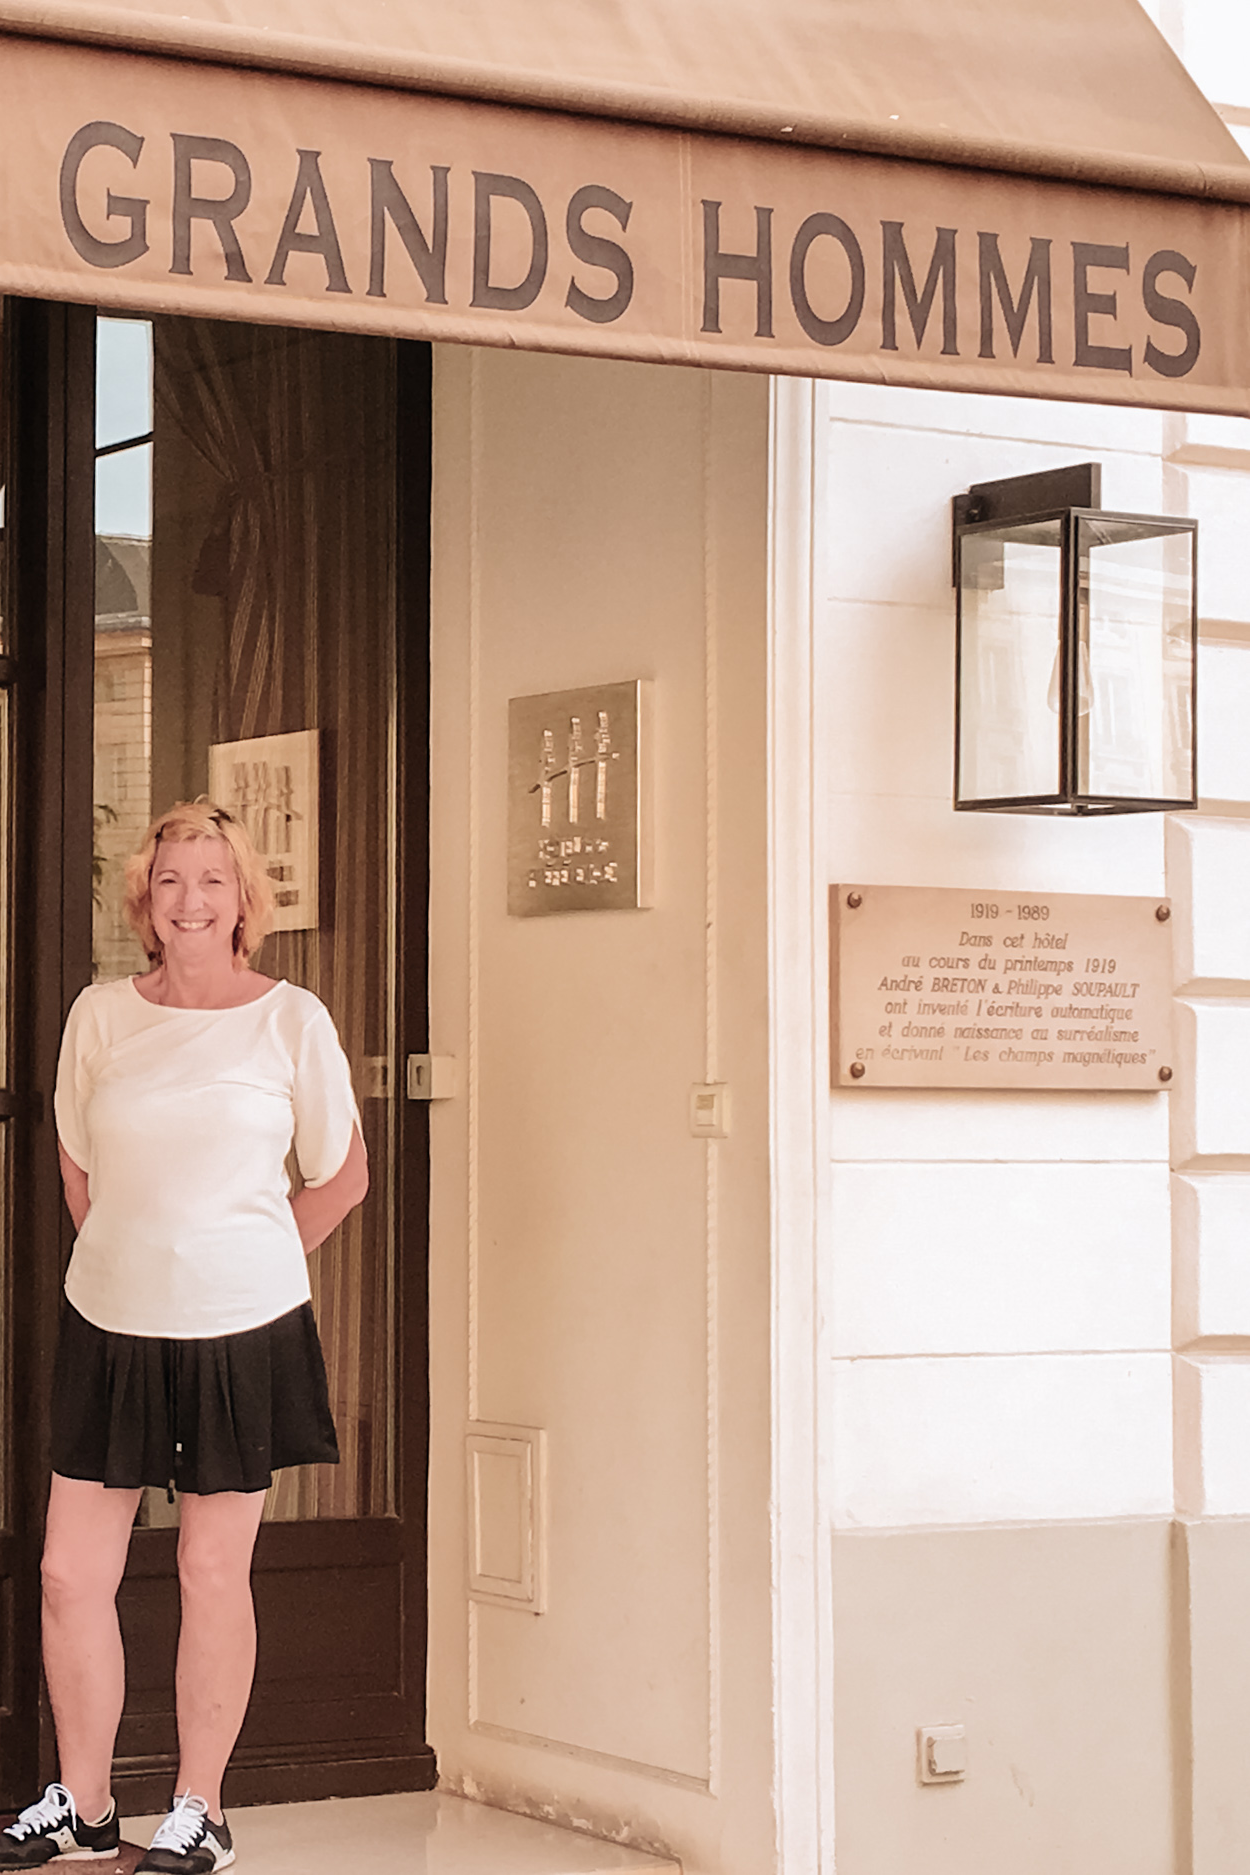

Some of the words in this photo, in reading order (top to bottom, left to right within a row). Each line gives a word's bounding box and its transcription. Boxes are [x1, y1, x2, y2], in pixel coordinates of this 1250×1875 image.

[60, 120, 635, 324] GRANDS
[700, 199, 1201, 378] HOMMES
[970, 903, 999, 919] 1919
[1017, 904, 1050, 921] 1989
[958, 931, 993, 947] Dans
[1003, 933, 1025, 948] cet
[1032, 932, 1069, 950] hôtel
[901, 955, 921, 968] au
[928, 956, 970, 969] cours
[978, 953, 996, 970] du
[1003, 955, 1074, 976] printemps
[1084, 958, 1116, 974] 1919
[877, 975, 924, 992] André
[930, 977, 988, 994] BRETON
[1006, 979, 1063, 999] Philippe
[1071, 982, 1140, 998] SOUPAULT
[884, 1000, 908, 1015] ont
[916, 999, 969, 1016] inventé
[976, 1000, 1043, 1018] l'écriture
[1050, 1003, 1133, 1024] automatique
[878, 1022, 893, 1038] et
[901, 1021, 946, 1038] donné
[953, 1023, 1023, 1040] naissance
[1031, 1028, 1049, 1041] au
[1056, 1025, 1139, 1043] surréalisme
[855, 1048, 875, 1060] en
[881, 1044, 944, 1061] écrivant
[998, 1048, 1054, 1067] champs
